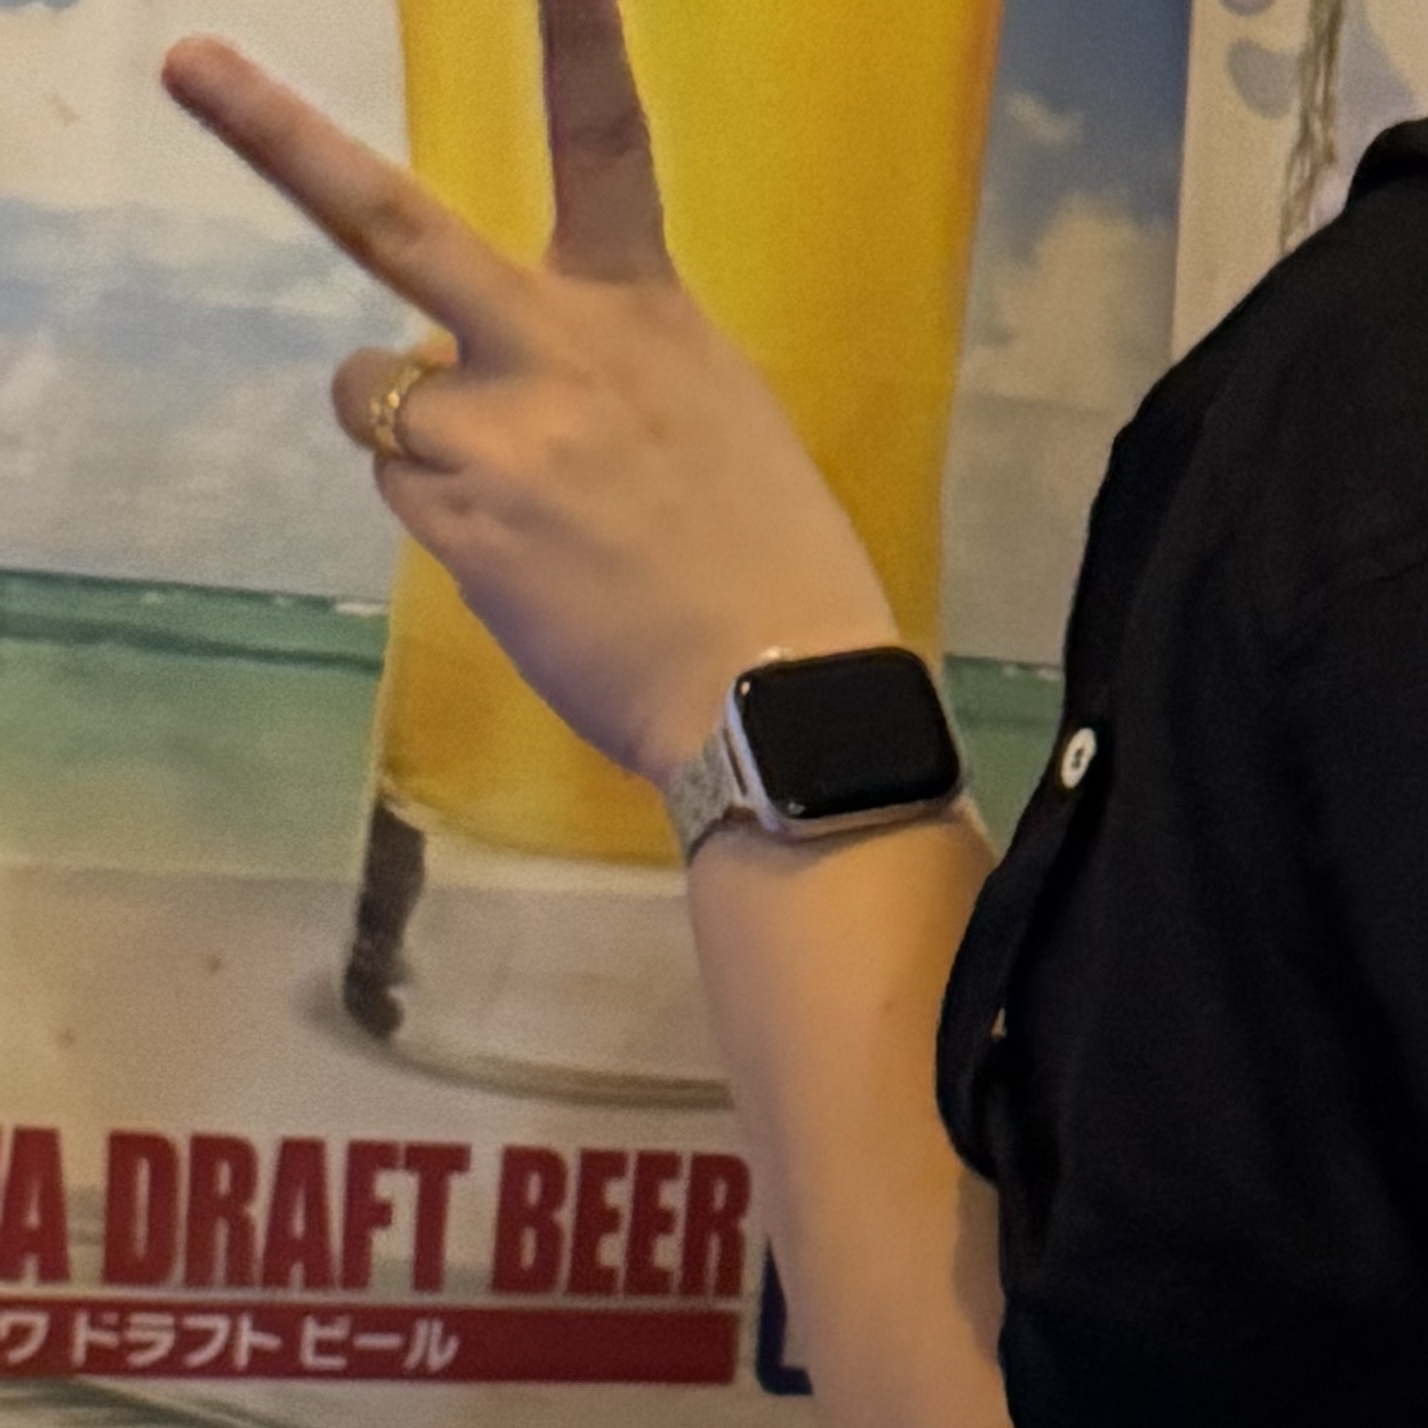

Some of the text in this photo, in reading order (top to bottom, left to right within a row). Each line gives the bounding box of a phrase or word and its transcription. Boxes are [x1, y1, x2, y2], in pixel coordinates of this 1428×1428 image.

[0, 1126, 752, 1298] A DRAFT BEER
[70, 1312, 282, 1369] ドラフト
[300, 1316, 461, 1373] ビール
